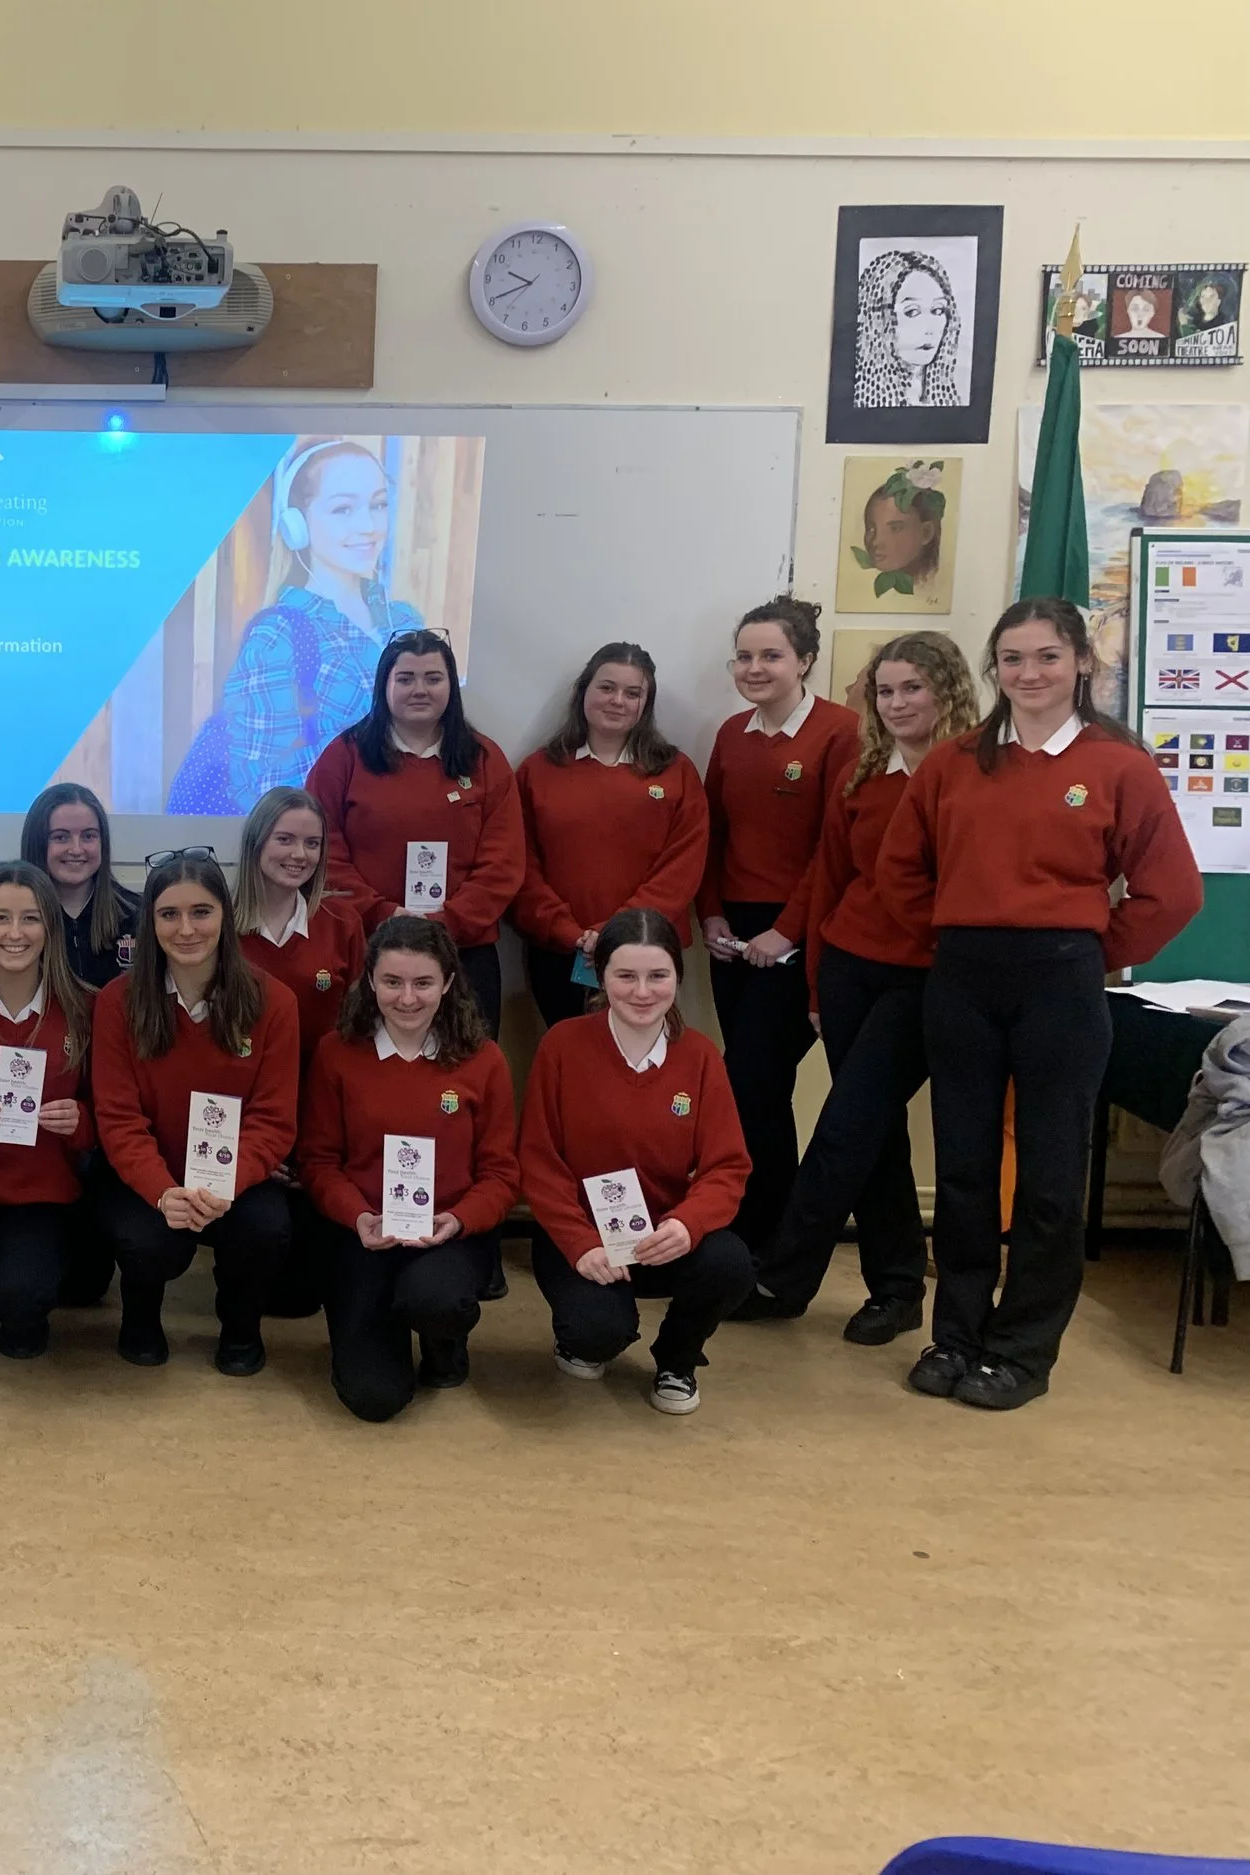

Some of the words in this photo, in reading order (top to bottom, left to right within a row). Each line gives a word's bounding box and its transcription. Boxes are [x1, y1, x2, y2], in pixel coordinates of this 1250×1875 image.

[511, 239, 522, 249] 11
[531, 234, 543, 245] 12
[554, 243, 559, 252] 1
[493, 254, 506, 264] 10
[566, 260, 574, 270] 2
[485, 274, 492, 284] 9
[1116, 273, 1168, 289] COMING
[569, 281, 576, 292] 3
[489, 296, 496, 307] 8
[560, 303, 567, 312] 4
[502, 314, 509, 323] 7
[542, 317, 549, 327] 5
[521, 321, 528, 331] 6
[1208, 329, 1225, 345] TO
[1117, 339, 1160, 356] SOON
[8, 548, 141, 568] AWARENESS
